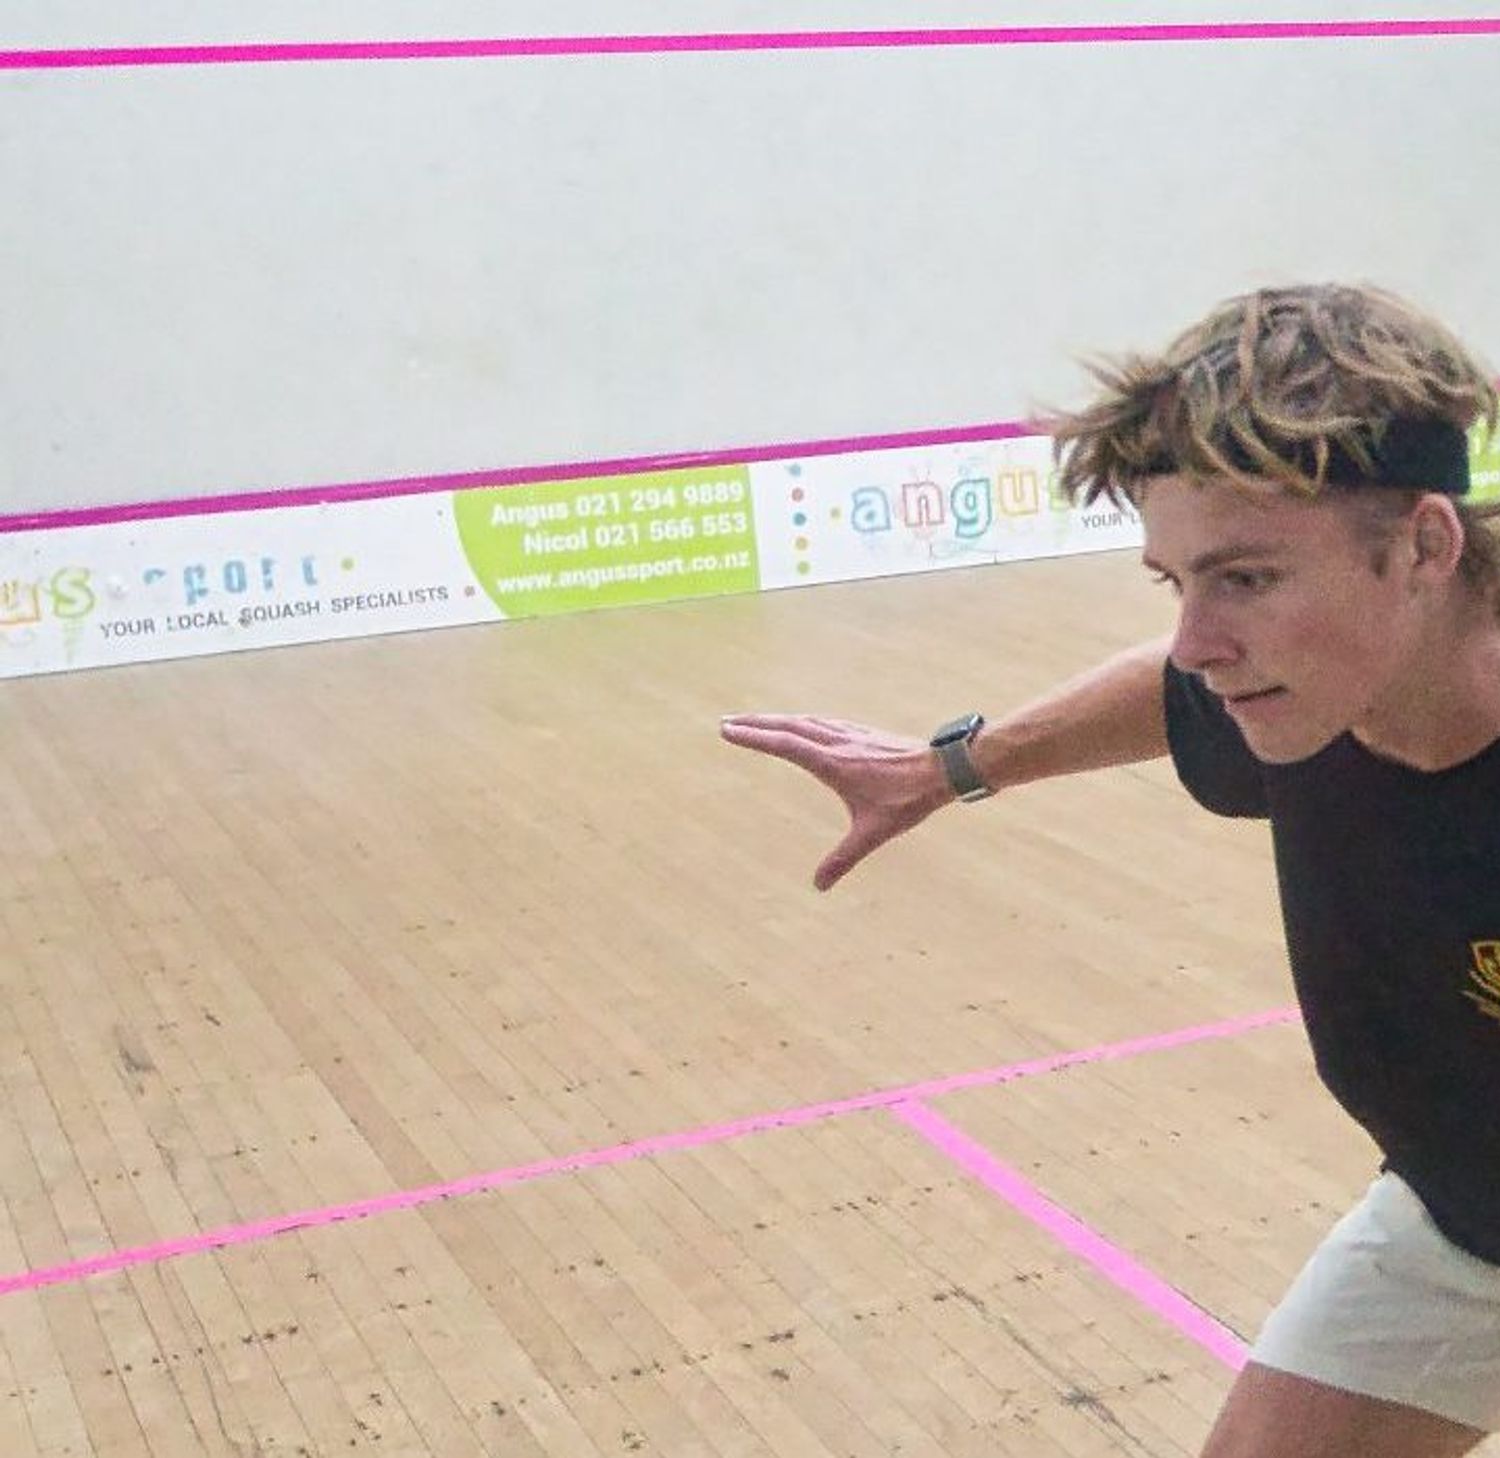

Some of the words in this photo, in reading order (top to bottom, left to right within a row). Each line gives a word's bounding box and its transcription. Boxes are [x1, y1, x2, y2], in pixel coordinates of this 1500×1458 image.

[491, 501, 568, 529] Angus
[576, 493, 620, 517] 021
[631, 487, 676, 512] 294
[683, 480, 743, 506] 9889
[524, 527, 588, 555] Nicol
[595, 522, 639, 547] 021
[650, 517, 695, 541] 566
[701, 511, 747, 536] 553
[497, 551, 751, 592] www.angussport.co.nz
[100, 616, 156, 639] YOUR
[167, 610, 228, 632] LOCAL
[239, 599, 321, 626] SQUASH
[331, 584, 449, 612] SPECIALISTS
